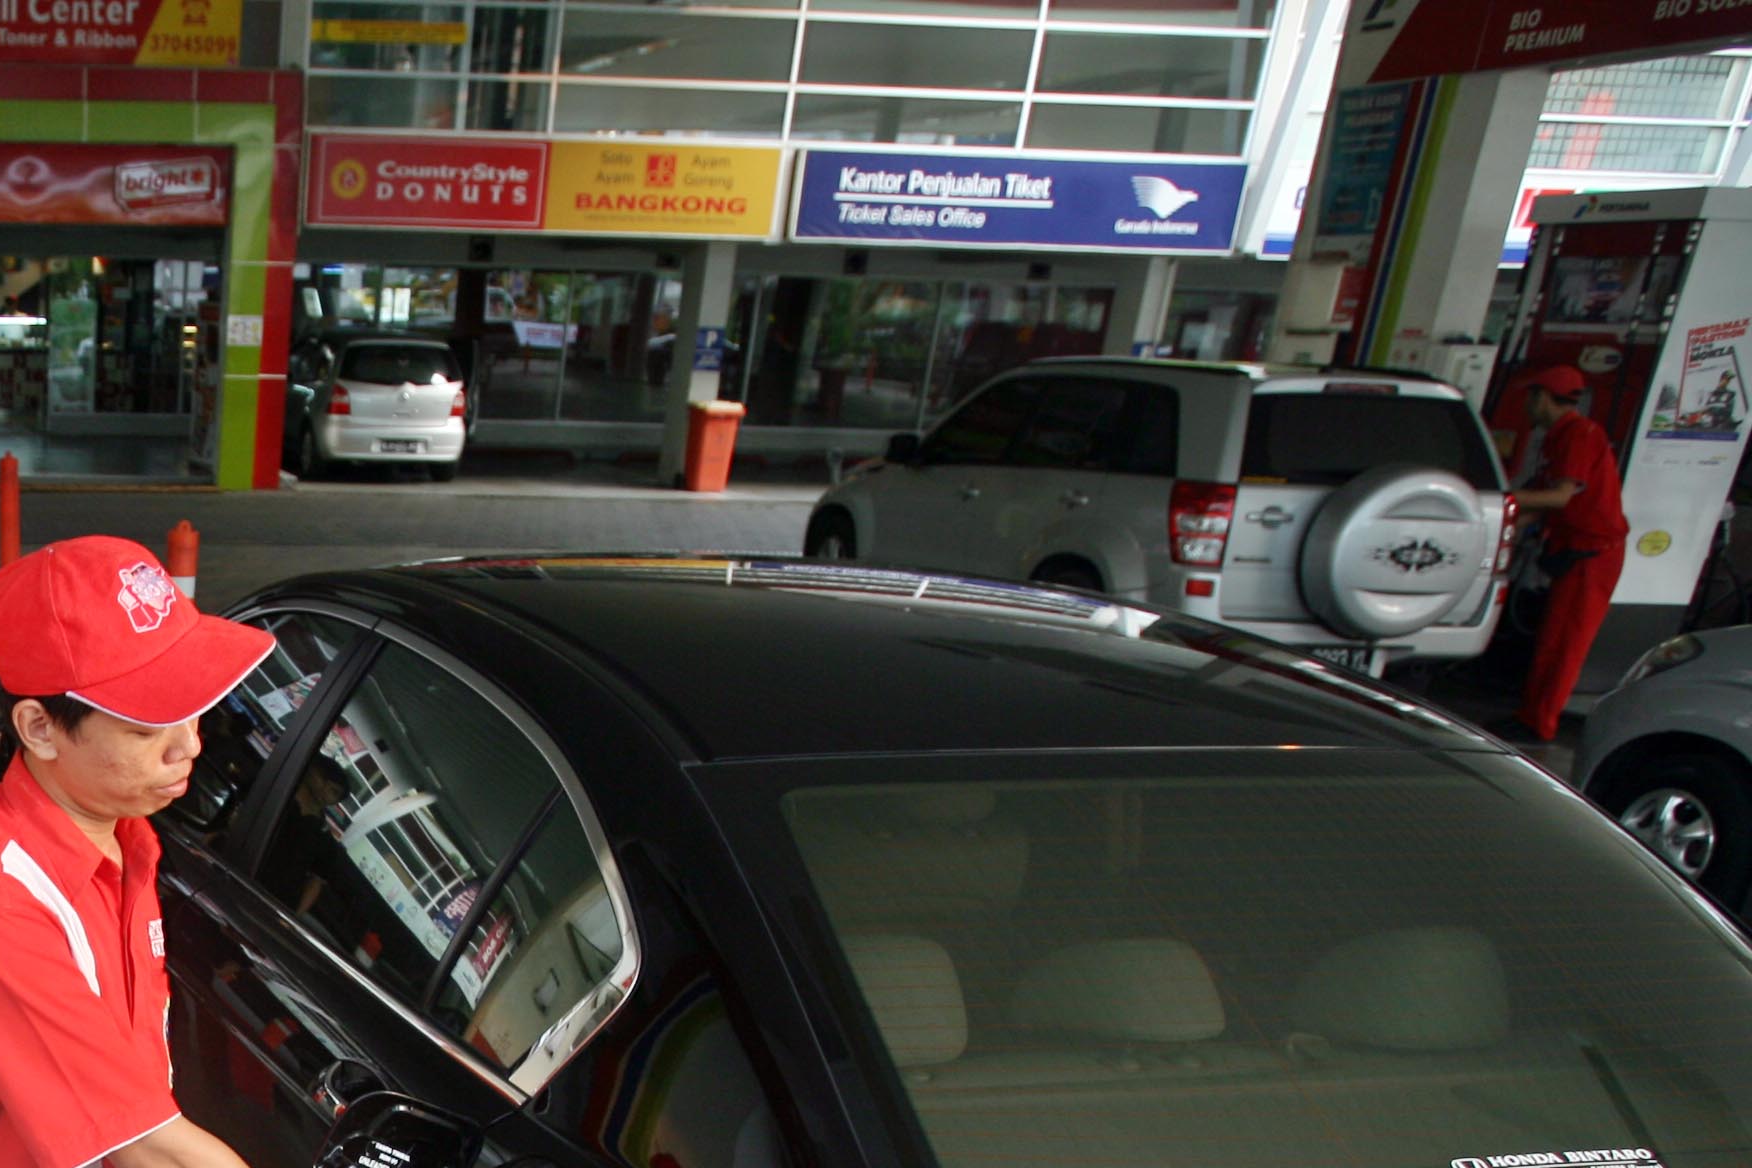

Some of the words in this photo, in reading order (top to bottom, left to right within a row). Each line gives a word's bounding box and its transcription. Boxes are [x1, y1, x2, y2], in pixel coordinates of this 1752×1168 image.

[29, 0, 139, 26] Center
[1509, 9, 1542, 31] BIO
[54, 29, 68, 48] &
[74, 30, 138, 49] Ribbon
[1504, 24, 1585, 52] PREMIUM
[377, 160, 530, 183] CountryStyle
[839, 167, 905, 193] Kantor
[907, 169, 1001, 198] Penjualan
[1005, 173, 1052, 199] Tiket
[375, 182, 527, 205] DONUTS
[575, 192, 747, 215] BANGKONG
[839, 203, 888, 225] Ticket
[889, 205, 935, 226] Sales
[938, 207, 986, 228] Office
[1486, 1152, 1563, 1168] HONDA
[1563, 1147, 1653, 1163] BINTARO
